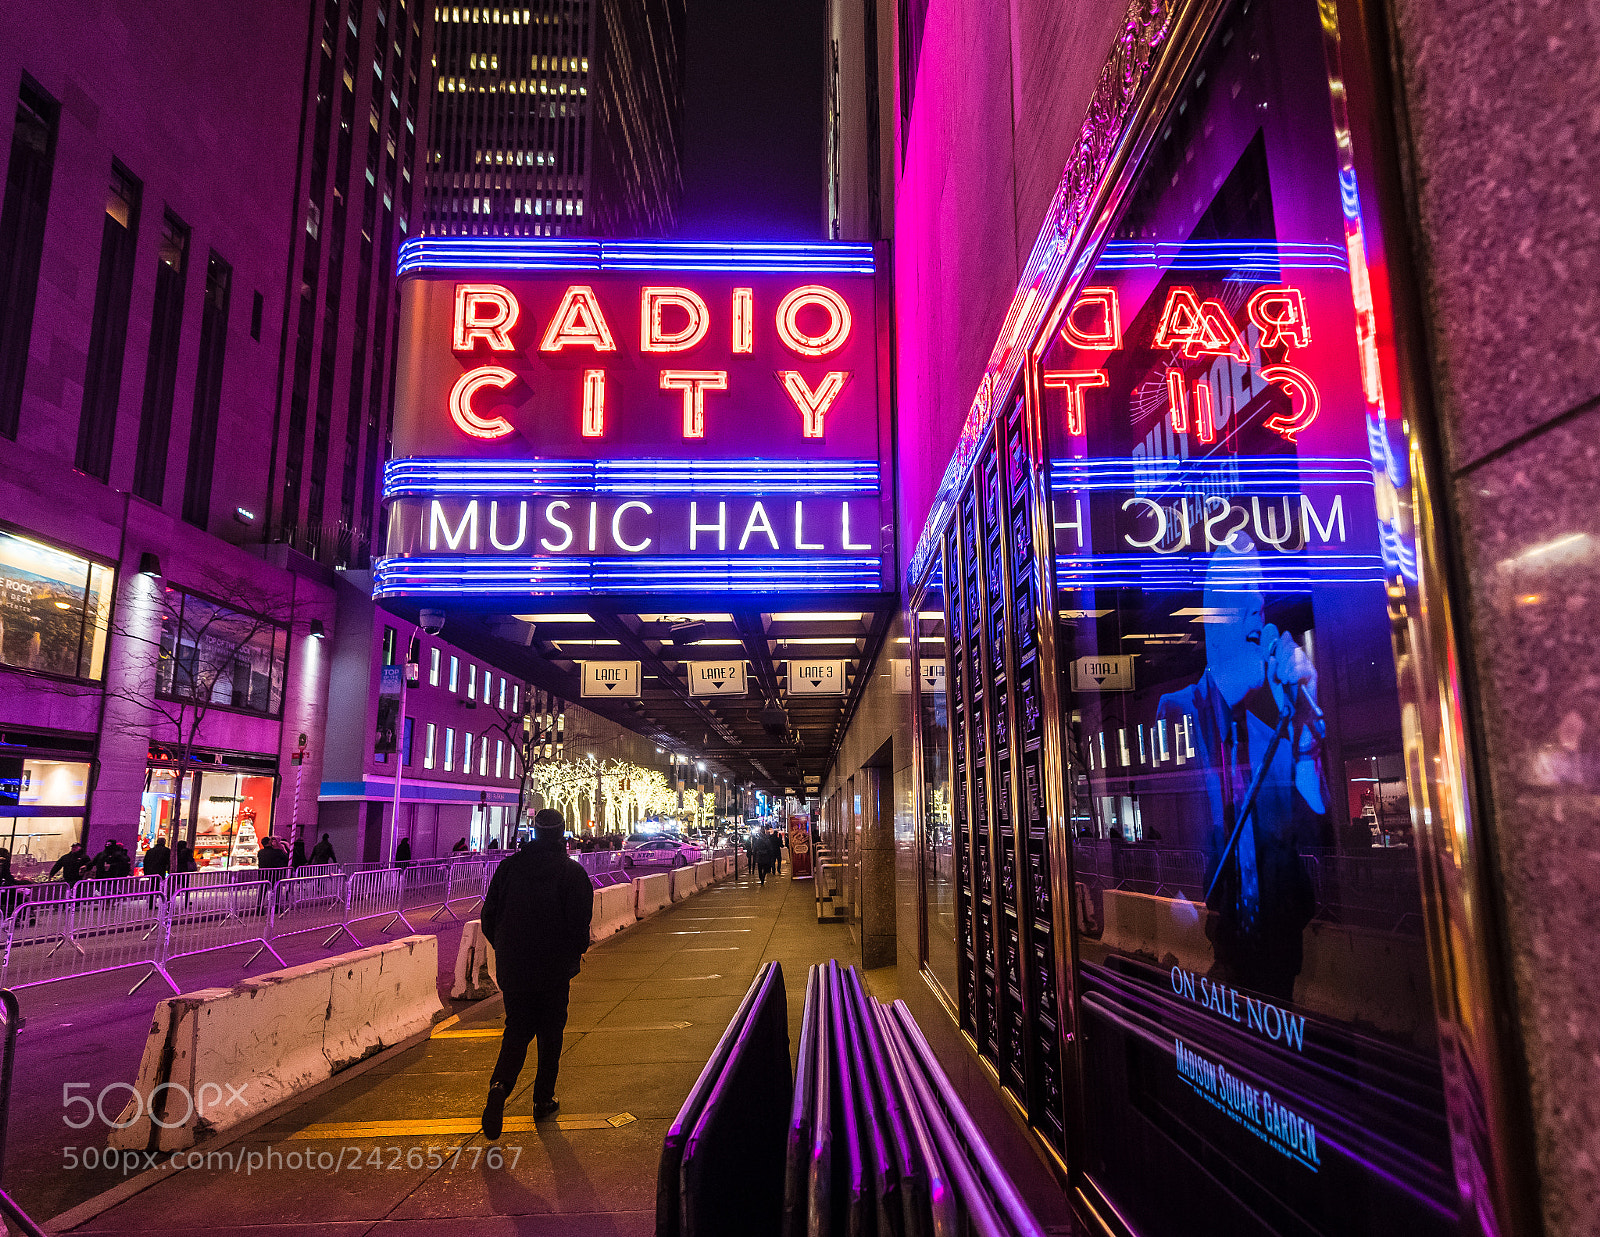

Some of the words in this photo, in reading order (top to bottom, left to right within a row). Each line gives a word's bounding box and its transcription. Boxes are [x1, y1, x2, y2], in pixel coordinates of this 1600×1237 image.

[451, 283, 851, 357] RADIO
[448, 365, 852, 439] CITY
[1132, 390, 1190, 506] BILLY
[428, 500, 654, 553] MUSIC
[689, 501, 873, 551] HALL
[6, 580, 33, 595] ROCK
[595, 668, 621, 682] LANE
[623, 668, 629, 681] 1
[700, 667, 727, 681] LANE
[728, 667, 736, 680] 2
[799, 666, 824, 680] LANE
[826, 666, 834, 679] 3
[1170, 965, 1196, 1002] ON
[1200, 976, 1241, 1023] SALE
[1246, 995, 1306, 1052] NOW
[1175, 1038, 1218, 1095] MADISON
[1218, 1063, 1262, 1126] SQUARE
[1262, 1090, 1318, 1163] GARDEN
